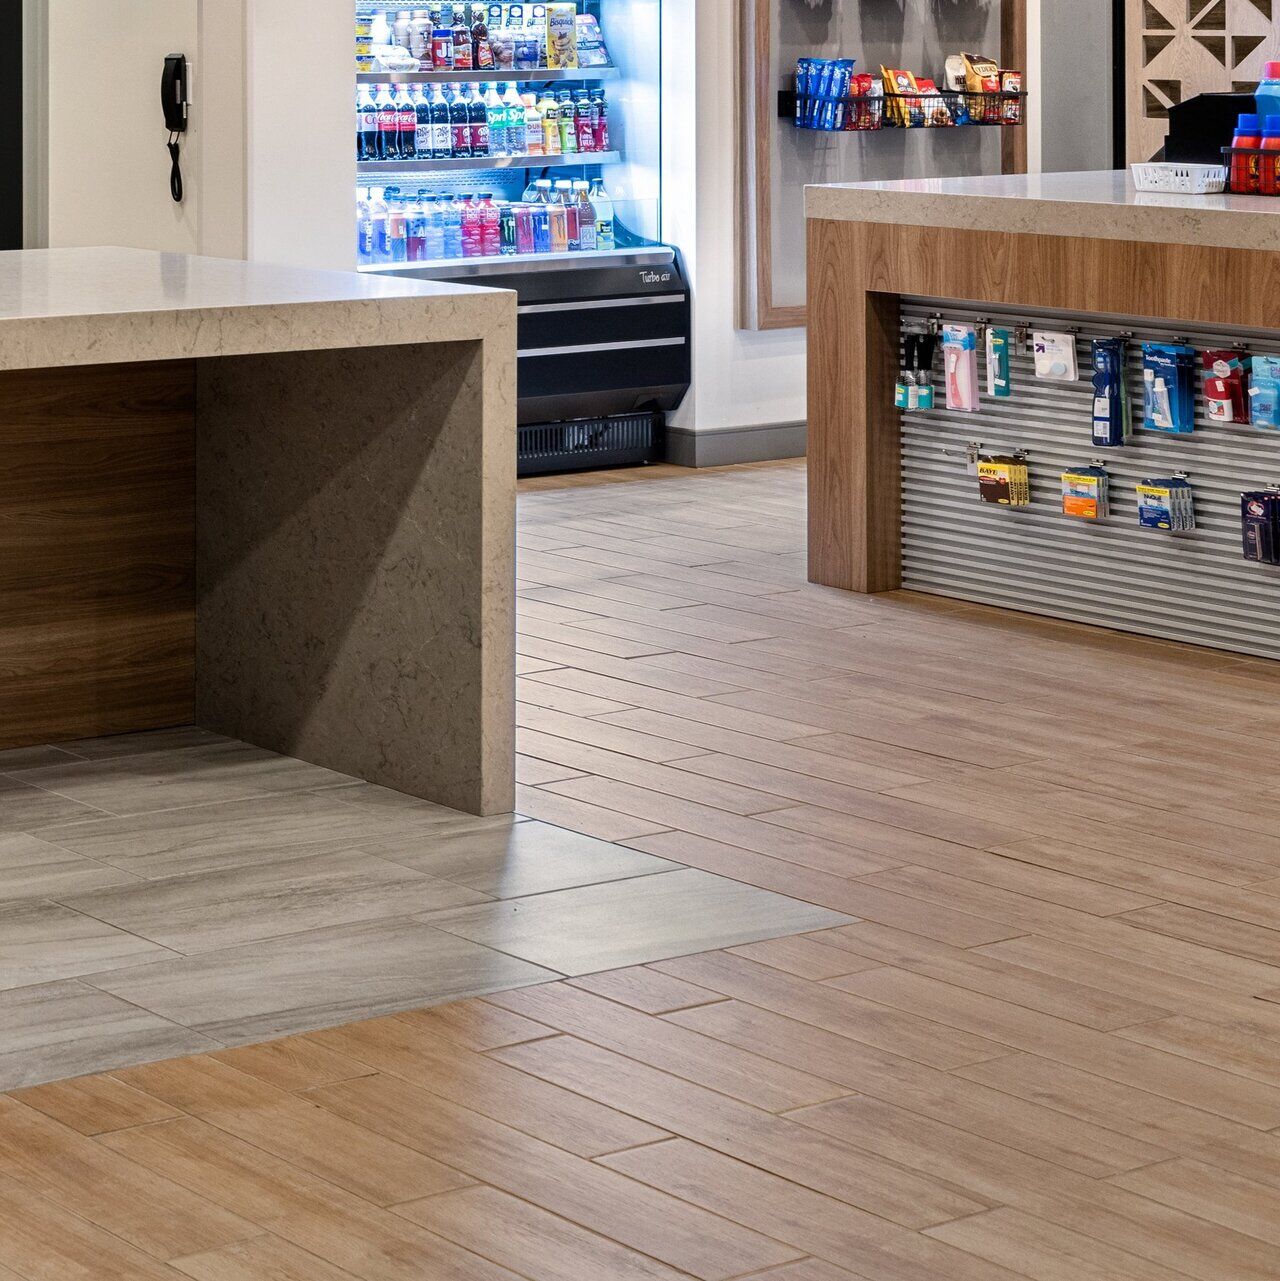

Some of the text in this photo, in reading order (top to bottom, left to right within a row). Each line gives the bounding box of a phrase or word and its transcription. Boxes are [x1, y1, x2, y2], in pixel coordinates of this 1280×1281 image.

[639, 271, 671, 283] Turbo air
[979, 467, 998, 475] BAYE
